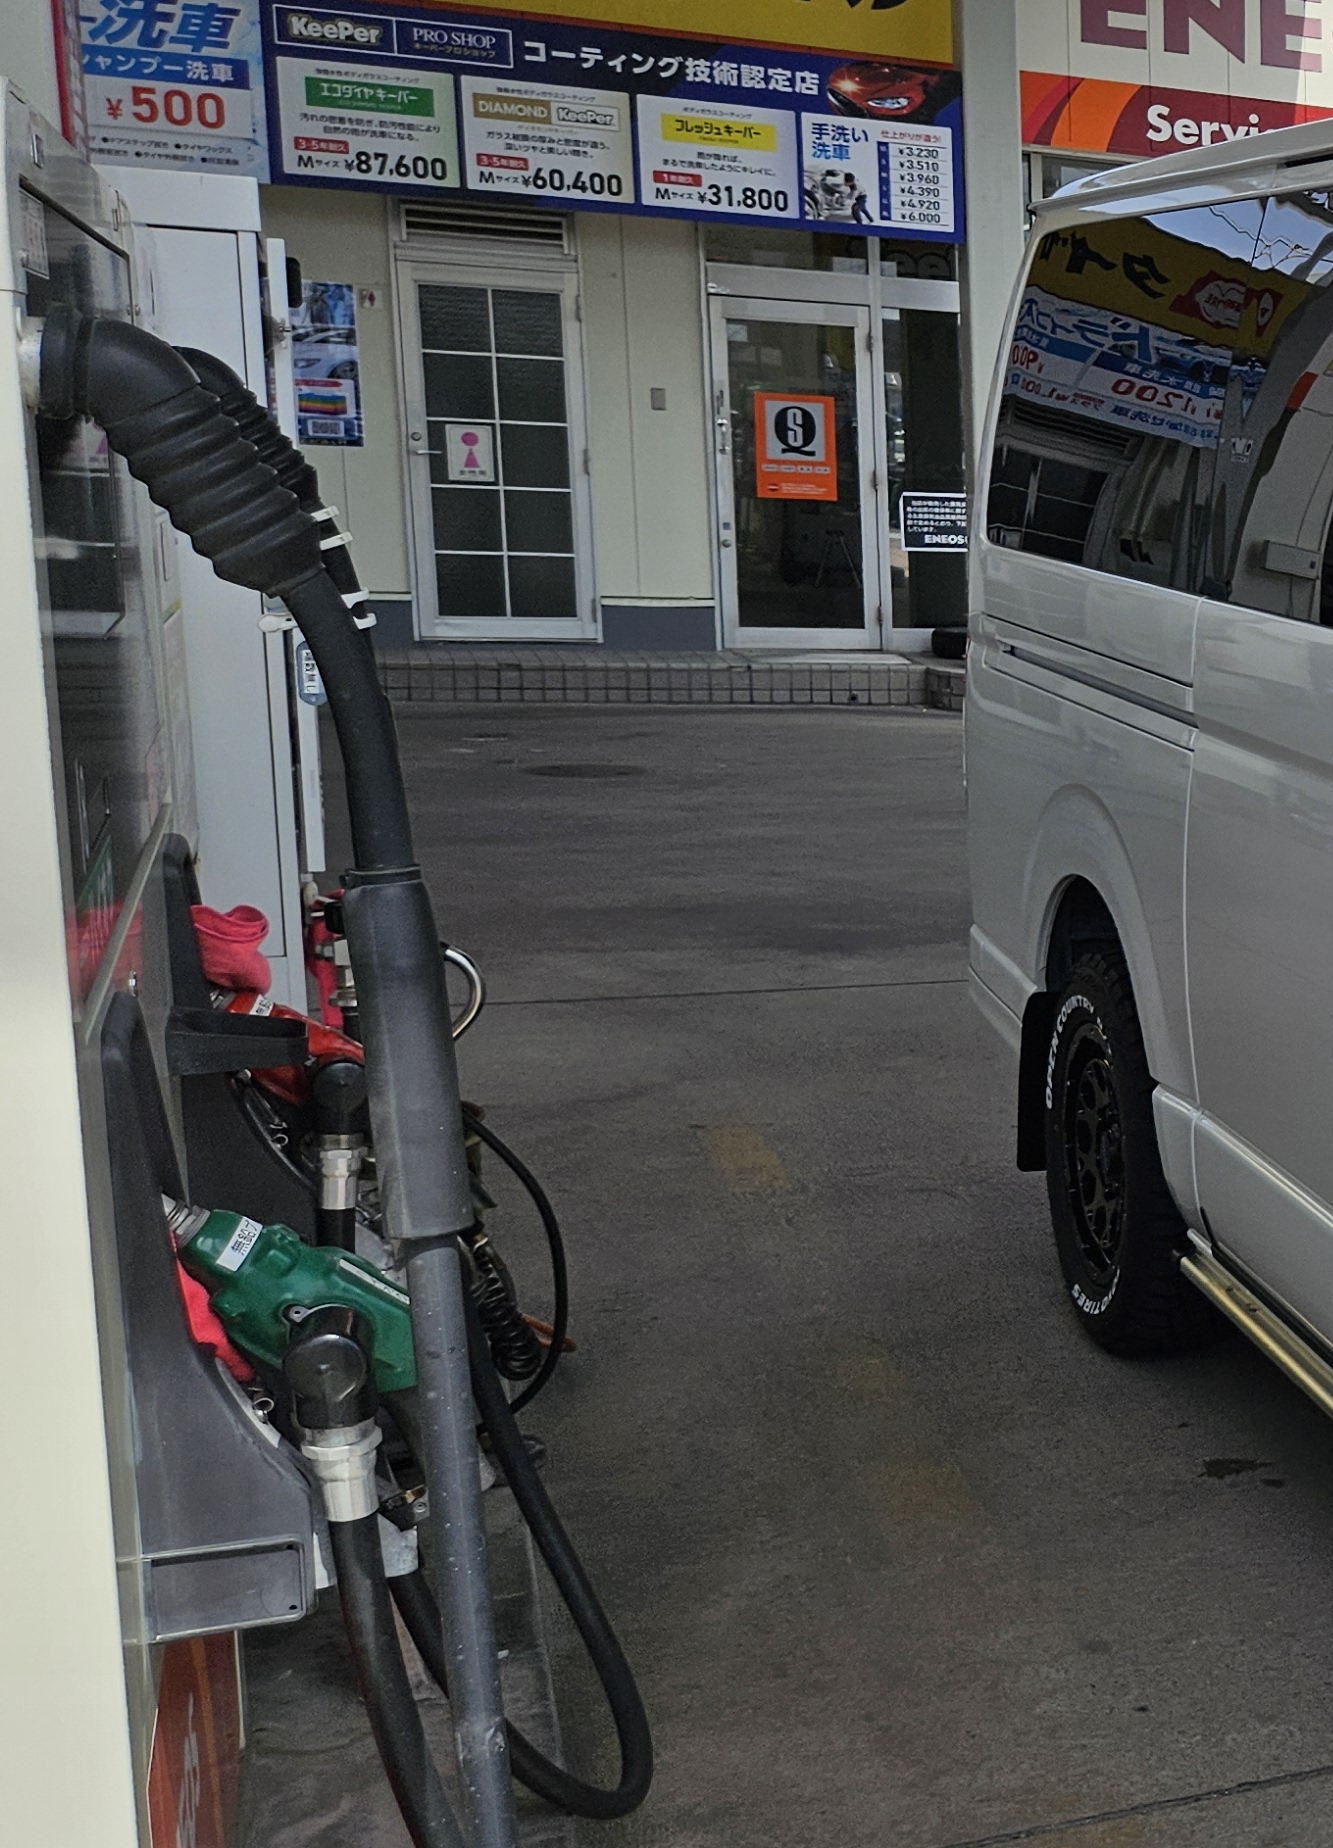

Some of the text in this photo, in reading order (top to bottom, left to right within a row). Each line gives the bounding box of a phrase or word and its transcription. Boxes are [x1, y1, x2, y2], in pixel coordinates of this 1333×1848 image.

[80, 0, 241, 52] 洗車
[289, 15, 381, 44] KeePer
[413, 27, 496, 49] PRO SHOP
[82, 55, 233, 82] ャンプー洗車
[524, 39, 820, 95] コーティング技術認定店
[106, 86, 226, 129] ¥500
[478, 100, 614, 126] DIAMOND KeePer
[811, 122, 869, 142] 手洗い
[1145, 104, 1281, 146] Servi
[812, 141, 851, 160] 洗車
[344, 151, 448, 181] ¥87,600
[521, 167, 623, 196] ¥60,400
[698, 184, 788, 211] ¥31,800
[924, 534, 968, 545] ENEOS
[1056, 995, 1095, 1033] COUNTRY
